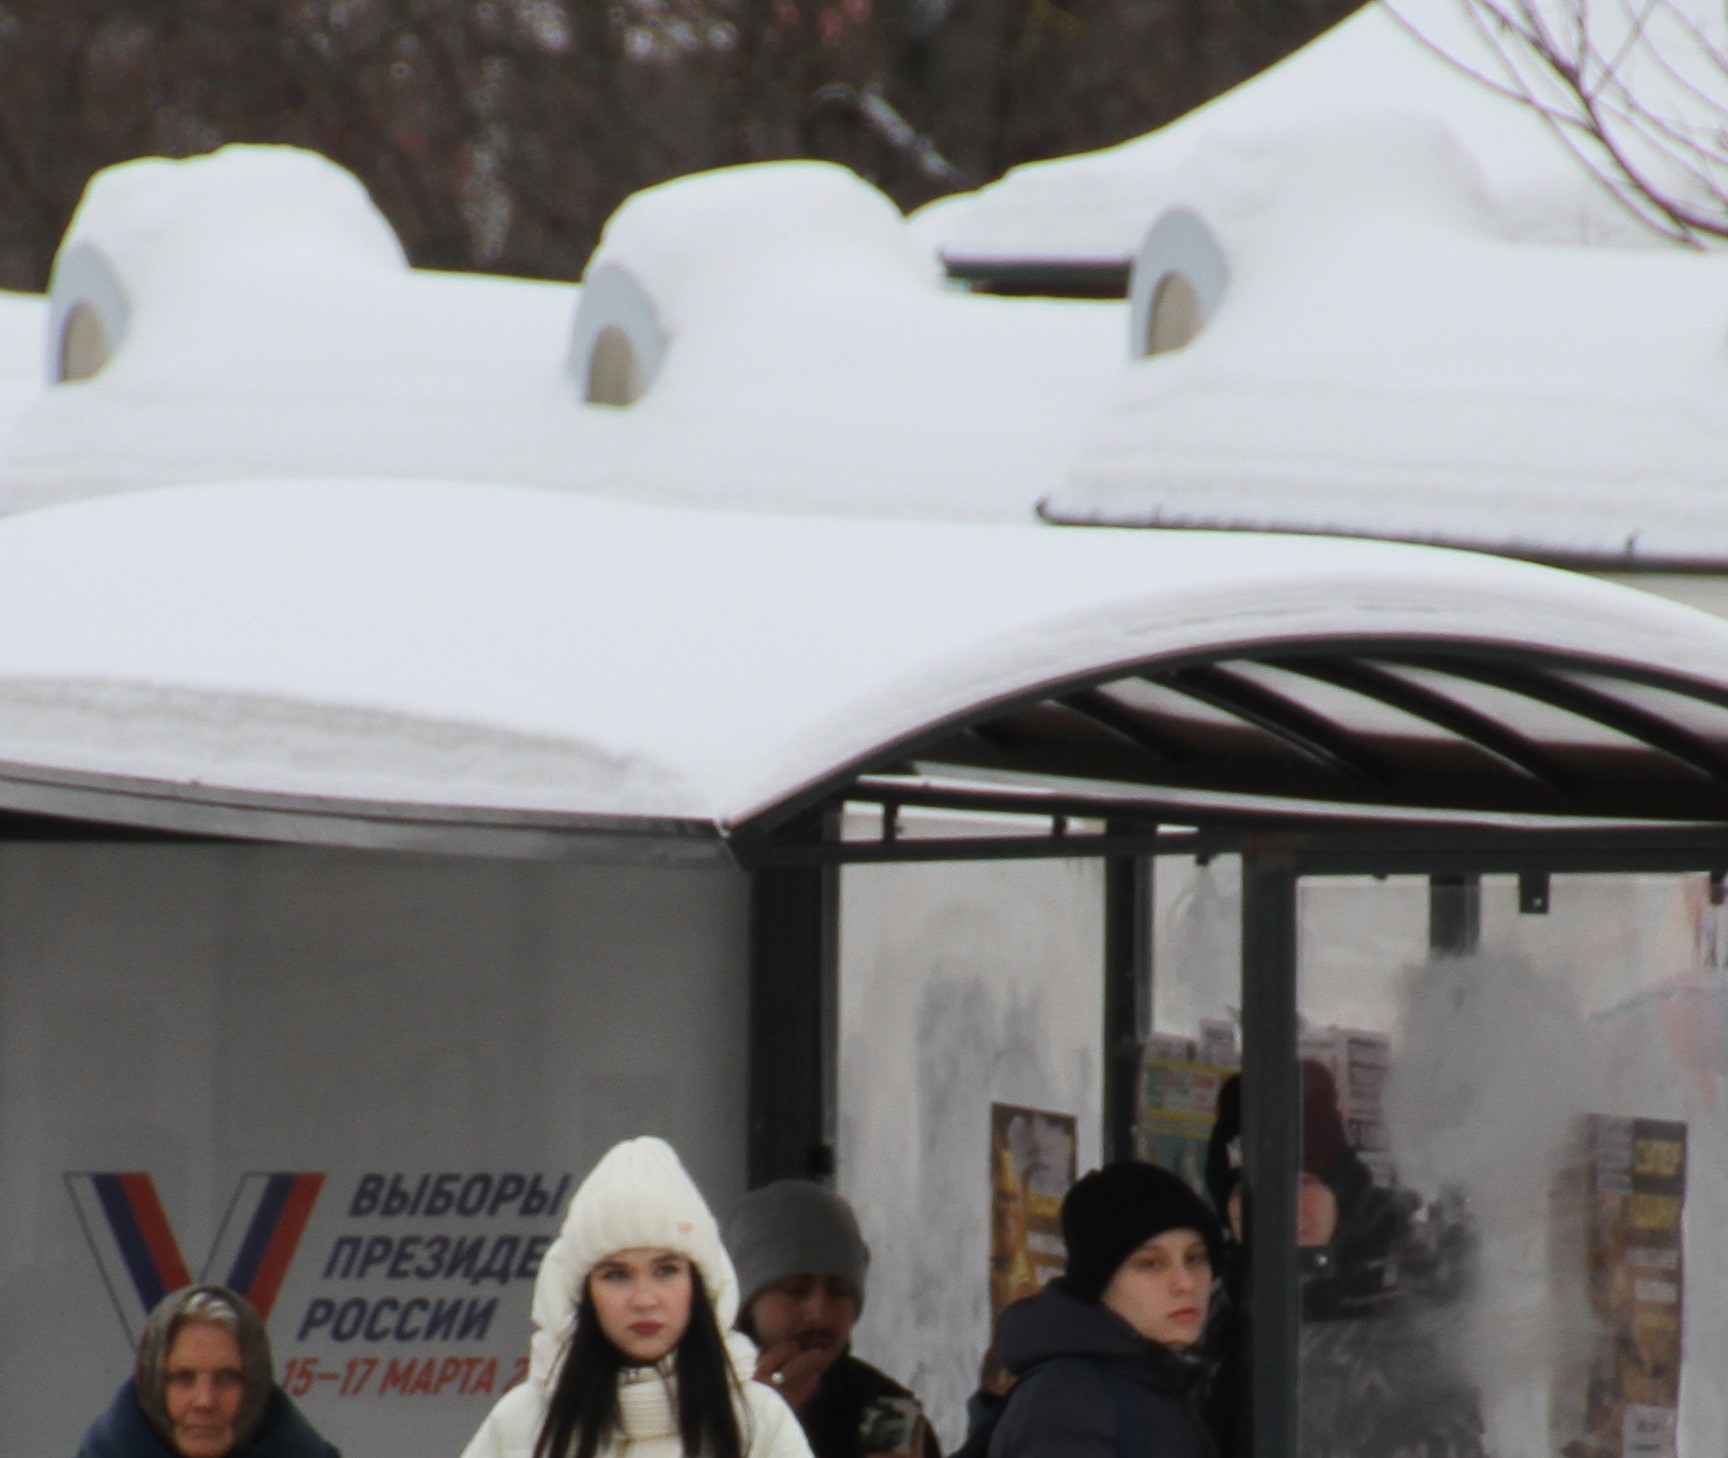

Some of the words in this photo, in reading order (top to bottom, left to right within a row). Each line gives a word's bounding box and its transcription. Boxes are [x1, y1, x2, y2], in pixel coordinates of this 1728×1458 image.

[349, 1173, 571, 1217] ВЫБОРЫ
[322, 1234, 557, 1286] ПРЕЗИДЕ
[296, 1297, 498, 1343] РОССИИ
[378, 1356, 499, 1396] МАРТА
